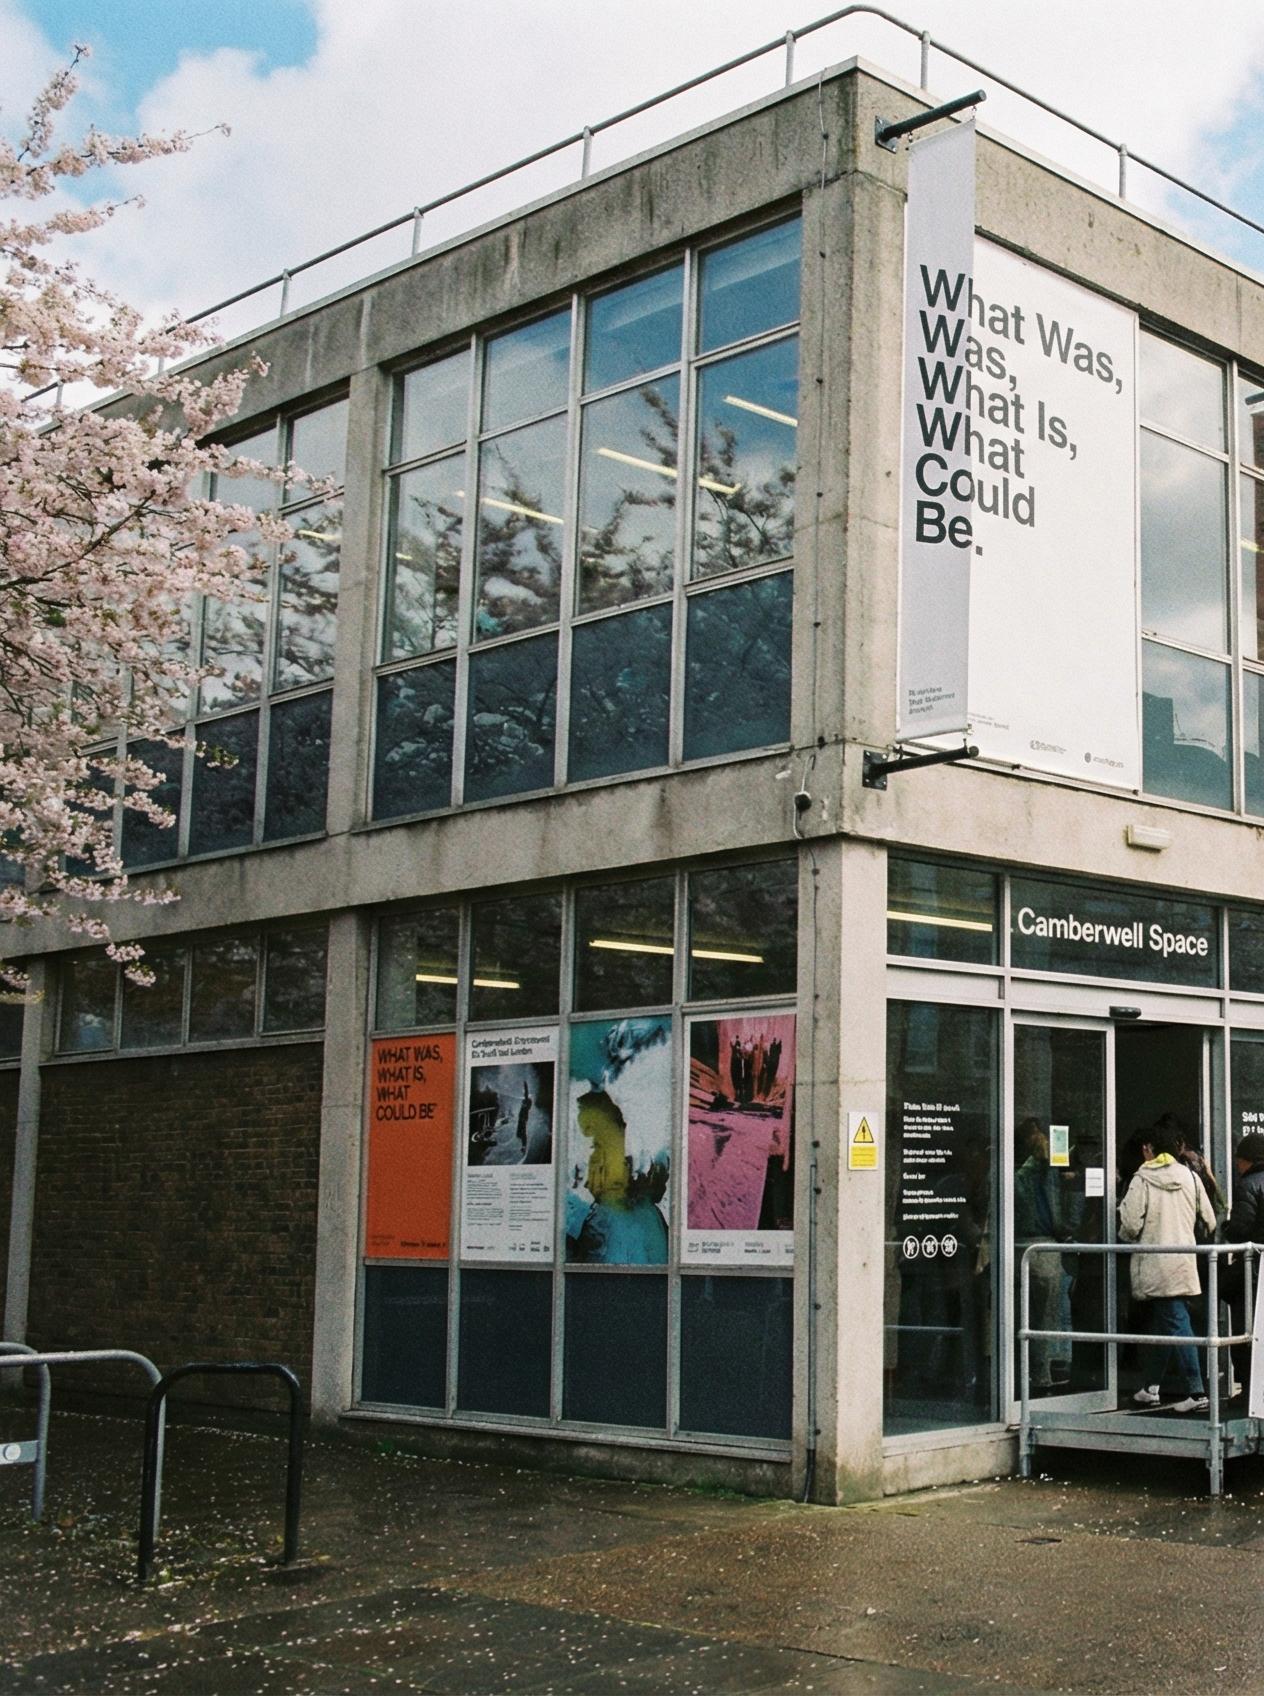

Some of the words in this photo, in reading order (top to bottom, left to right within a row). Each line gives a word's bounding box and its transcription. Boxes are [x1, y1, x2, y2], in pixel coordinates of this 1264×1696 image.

[919, 264, 1025, 345] What
[1036, 313, 1122, 394] Was,
[919, 310, 1017, 391] Was,
[917, 356, 1025, 434] What
[1038, 401, 1077, 460] Is,
[916, 403, 1025, 479] What
[915, 452, 1035, 528] Could
[915, 500, 983, 556] Be.
[1018, 907, 1143, 948] Camberwell
[1149, 924, 1208, 958] Space
[377, 1046, 411, 1064] WHAT
[414, 1044, 443, 1063] WAS,
[377, 1066, 411, 1083] WHAT
[413, 1065, 426, 1084] IS,
[376, 1085, 411, 1102] WHAT
[376, 1103, 417, 1121] COULD
